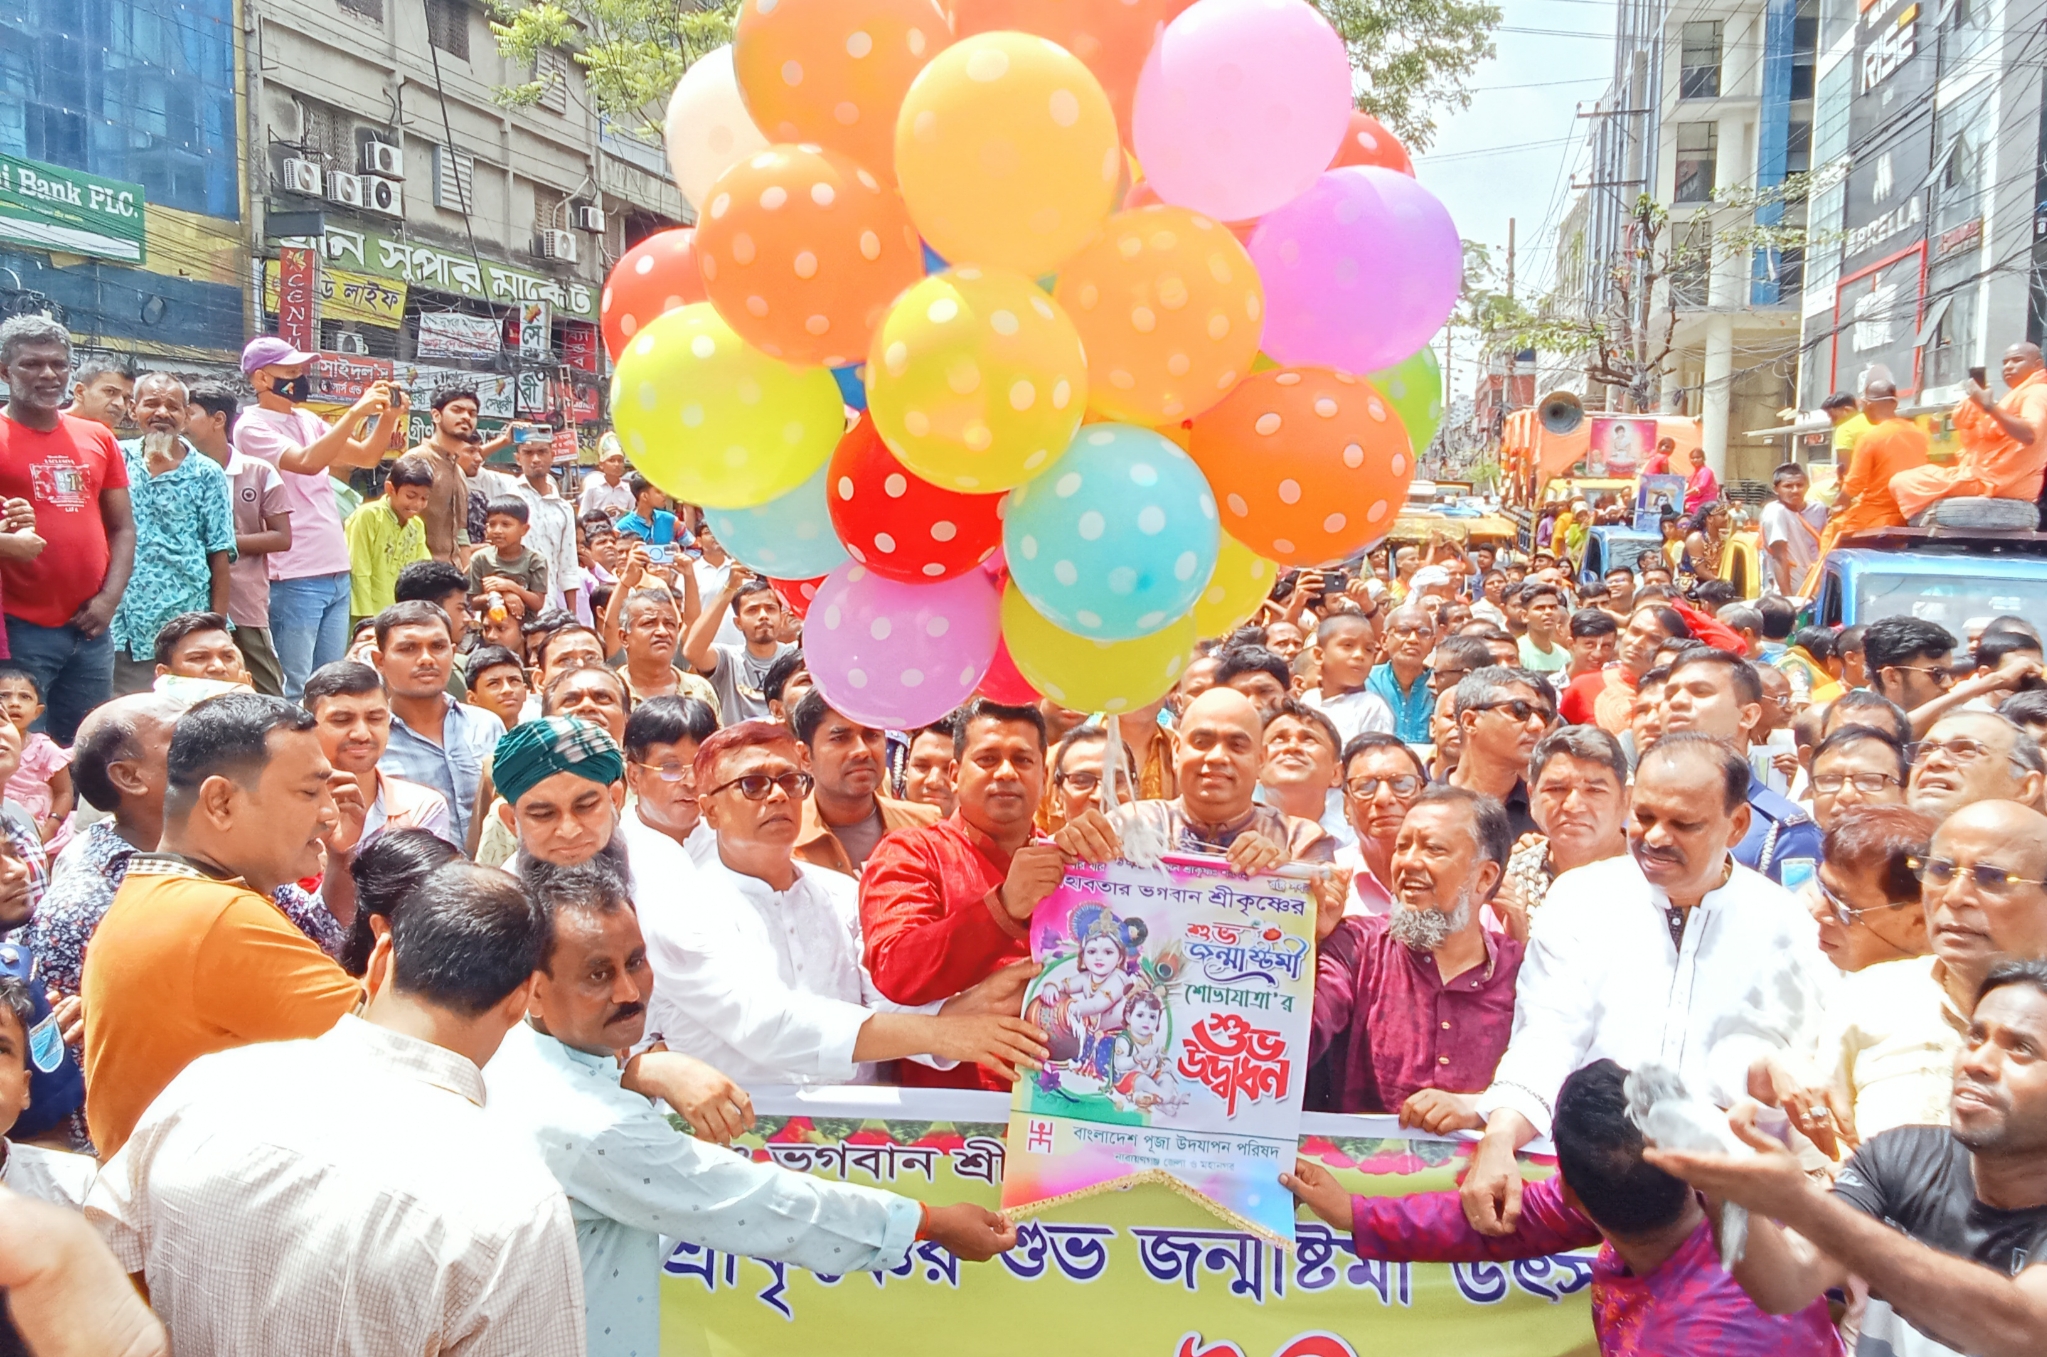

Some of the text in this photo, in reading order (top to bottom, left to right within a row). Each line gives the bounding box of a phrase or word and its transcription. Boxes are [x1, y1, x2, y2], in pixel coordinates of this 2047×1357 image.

[1861, 20, 1917, 96] RISE
[0, 164, 11, 192] i
[18, 167, 82, 206] Bank
[88, 184, 139, 218] PLC.
[343, 280, 400, 311] লাইফ
[378, 239, 482, 293] সুপার
[488, 267, 591, 314] মার্কেট
[1060, 876, 1306, 916] হাবতার ভগবান শ্রীকৃষ্ণের
[1191, 1012, 1287, 1062] শুভ
[767, 1142, 941, 1182] ভগবান
[1073, 1126, 1281, 1159] বাংলাদেশ পূজা উদযাপন পরিষদ
[1000, 1220, 1115, 1280] শুভ
